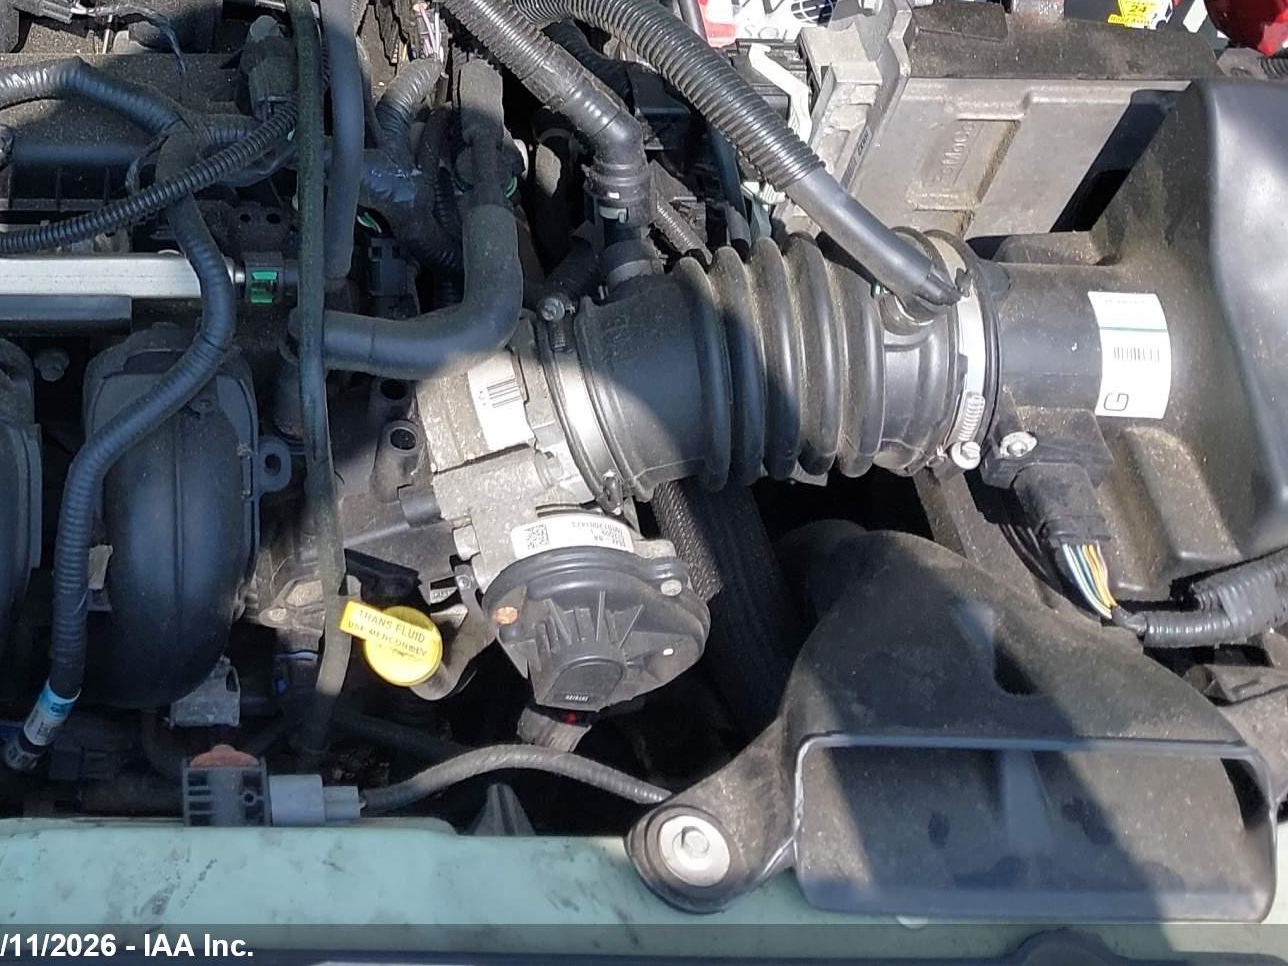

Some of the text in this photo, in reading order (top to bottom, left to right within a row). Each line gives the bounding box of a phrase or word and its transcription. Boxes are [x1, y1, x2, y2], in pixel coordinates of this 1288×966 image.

[1129, 4, 1148, 14] 24
[1103, 391, 1129, 412] G
[359, 609, 426, 643] TRANS FLUID
